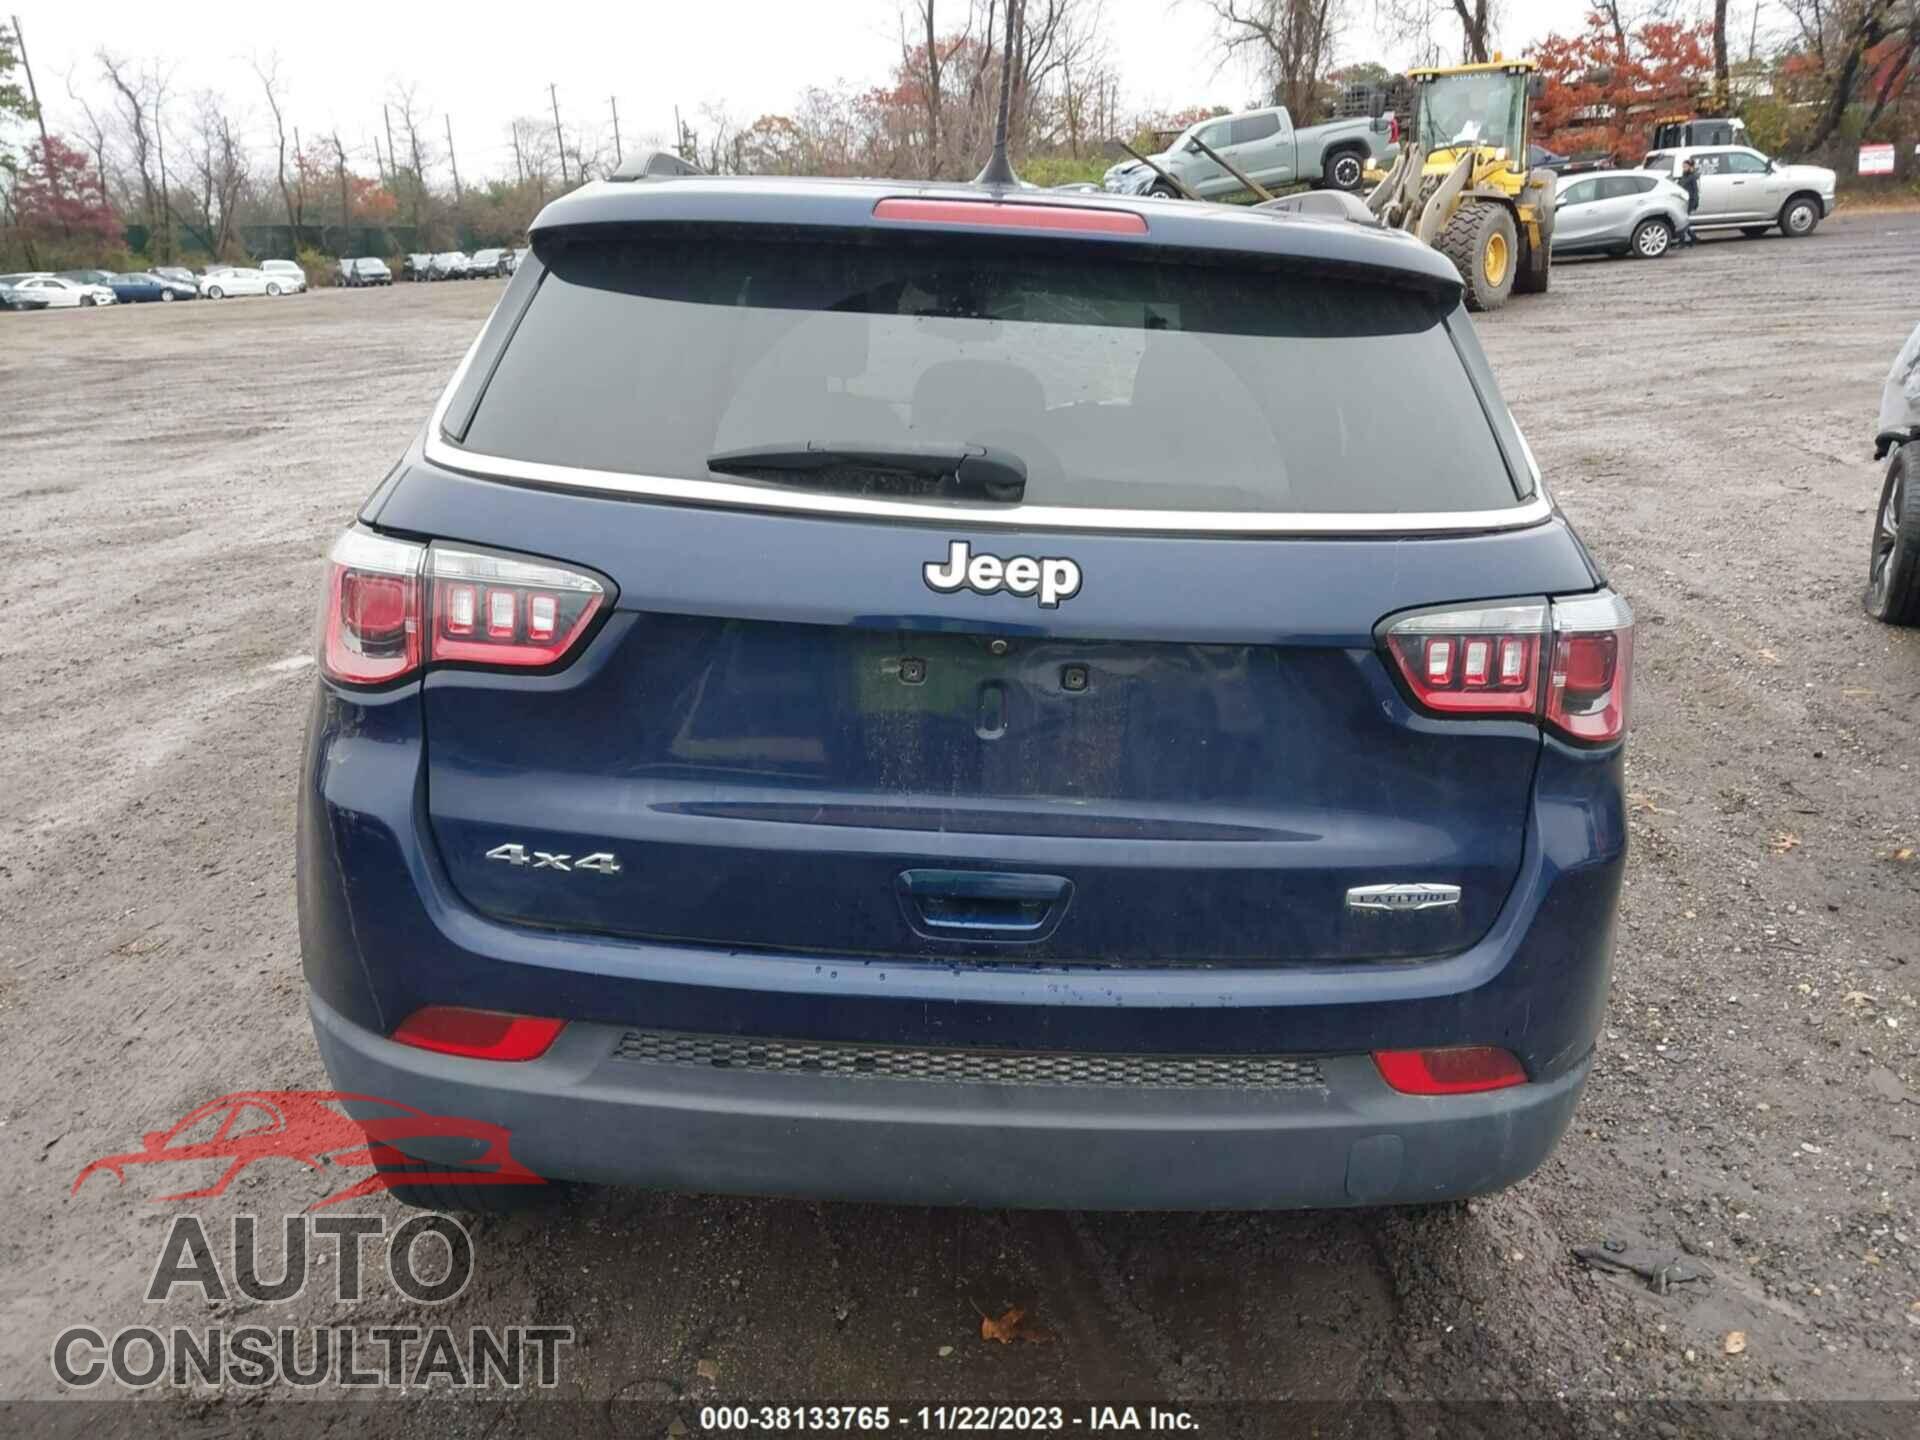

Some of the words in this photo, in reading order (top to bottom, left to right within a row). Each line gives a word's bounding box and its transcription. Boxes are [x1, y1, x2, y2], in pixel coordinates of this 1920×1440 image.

[923, 540, 1083, 608] Jeep
[486, 843, 621, 873] 4x4
[1359, 892, 1447, 902] LATITUDE
